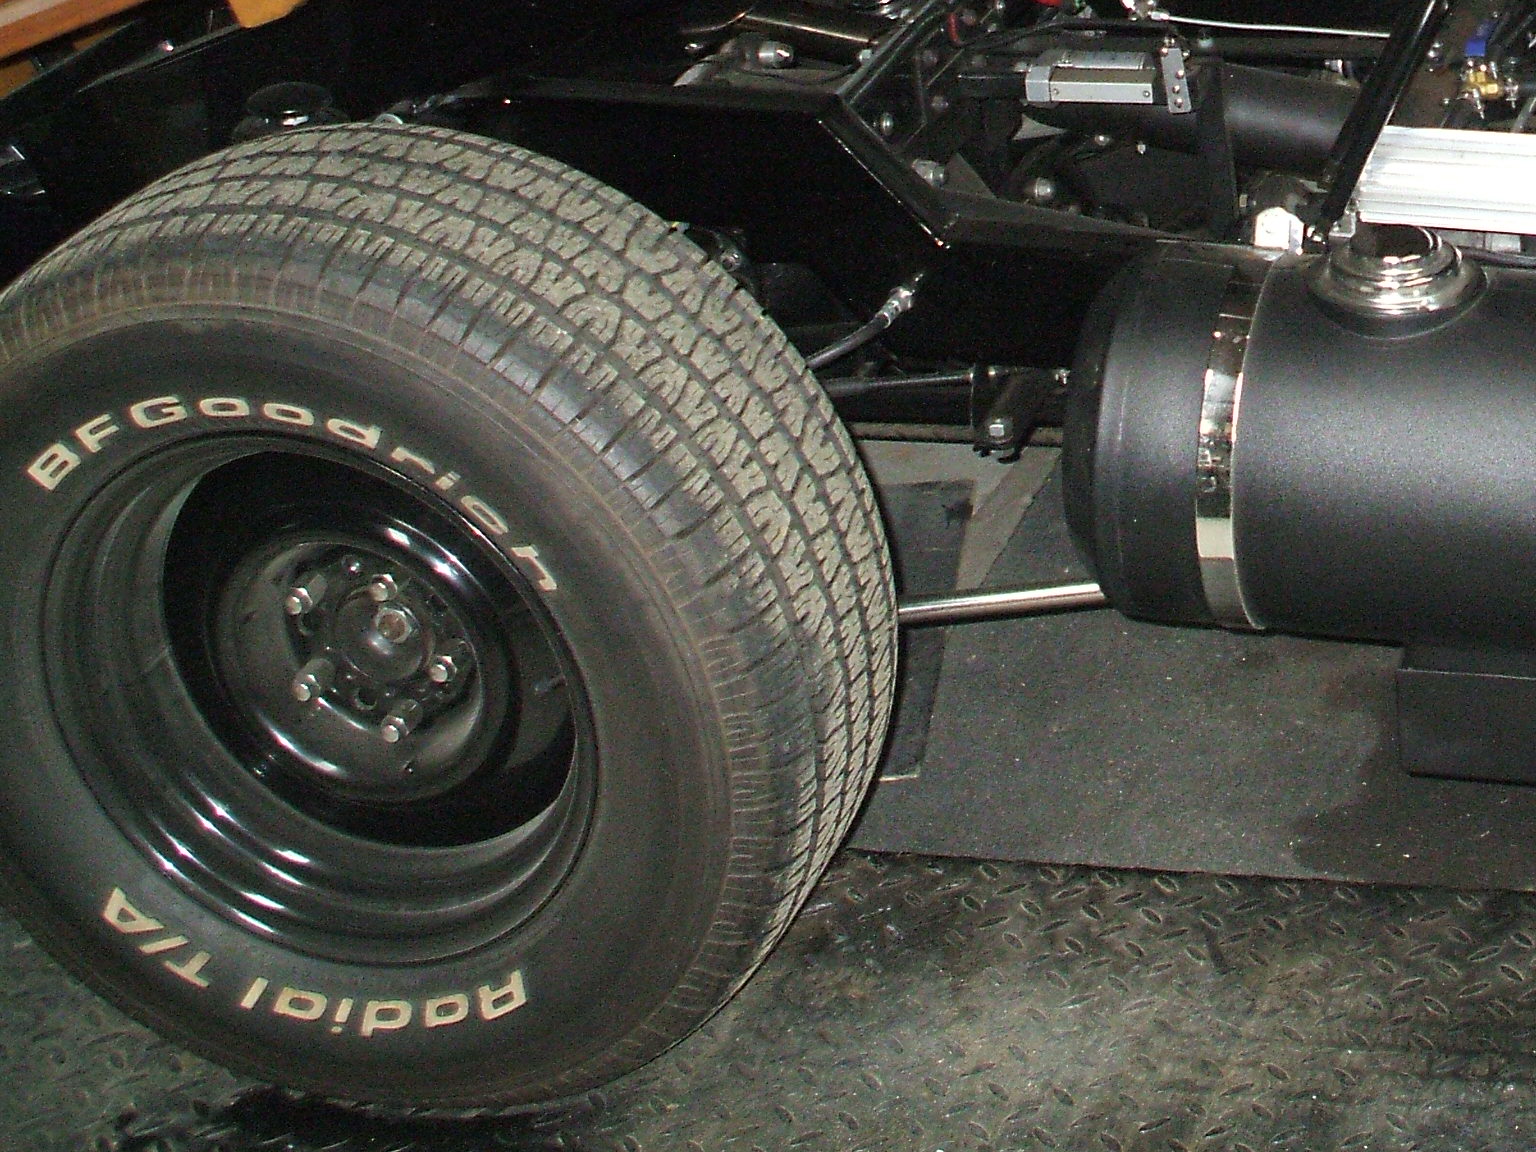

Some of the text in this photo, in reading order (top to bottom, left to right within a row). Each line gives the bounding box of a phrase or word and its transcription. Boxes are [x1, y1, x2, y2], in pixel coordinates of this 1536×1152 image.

[27, 395, 557, 592] BFGoodrich
[102, 886, 529, 1038] Radial T/A
